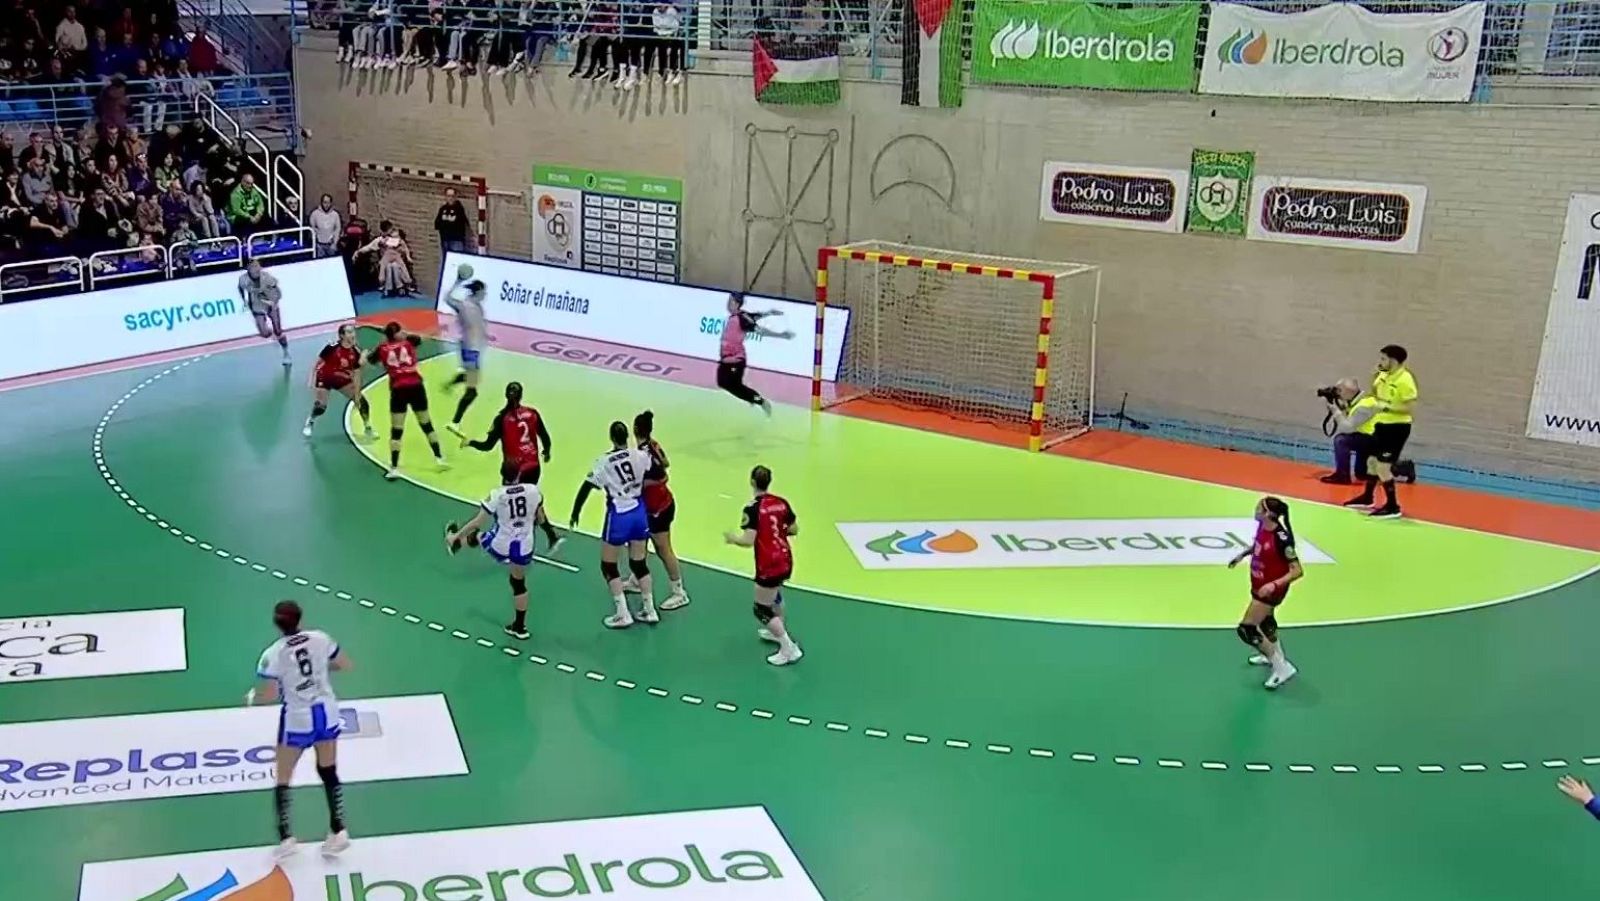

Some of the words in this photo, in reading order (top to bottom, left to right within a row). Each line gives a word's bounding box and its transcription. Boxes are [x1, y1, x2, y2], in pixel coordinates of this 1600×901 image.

[1044, 30, 1174, 62] Iberdrola
[1272, 37, 1404, 68] Iberdrola
[1060, 177, 1114, 201] Pedro
[1123, 182, 1165, 206] Luis
[1273, 193, 1336, 219] Pedro
[1348, 198, 1396, 225] Luis
[500, 280, 531, 305] Soñar
[533, 285, 544, 307] el
[544, 289, 590, 315] mañana
[124, 298, 236, 331] sacyr.com
[387, 346, 413, 368] 44
[529, 340, 683, 379] Gerflor
[517, 421, 531, 443] 2
[614, 461, 636, 485] 19
[508, 496, 527, 520] 18
[991, 531, 1251, 553] Iberdrol
[295, 647, 313, 677] 6
[143, 769, 279, 789] Material
[325, 844, 785, 901] Iberdrola
